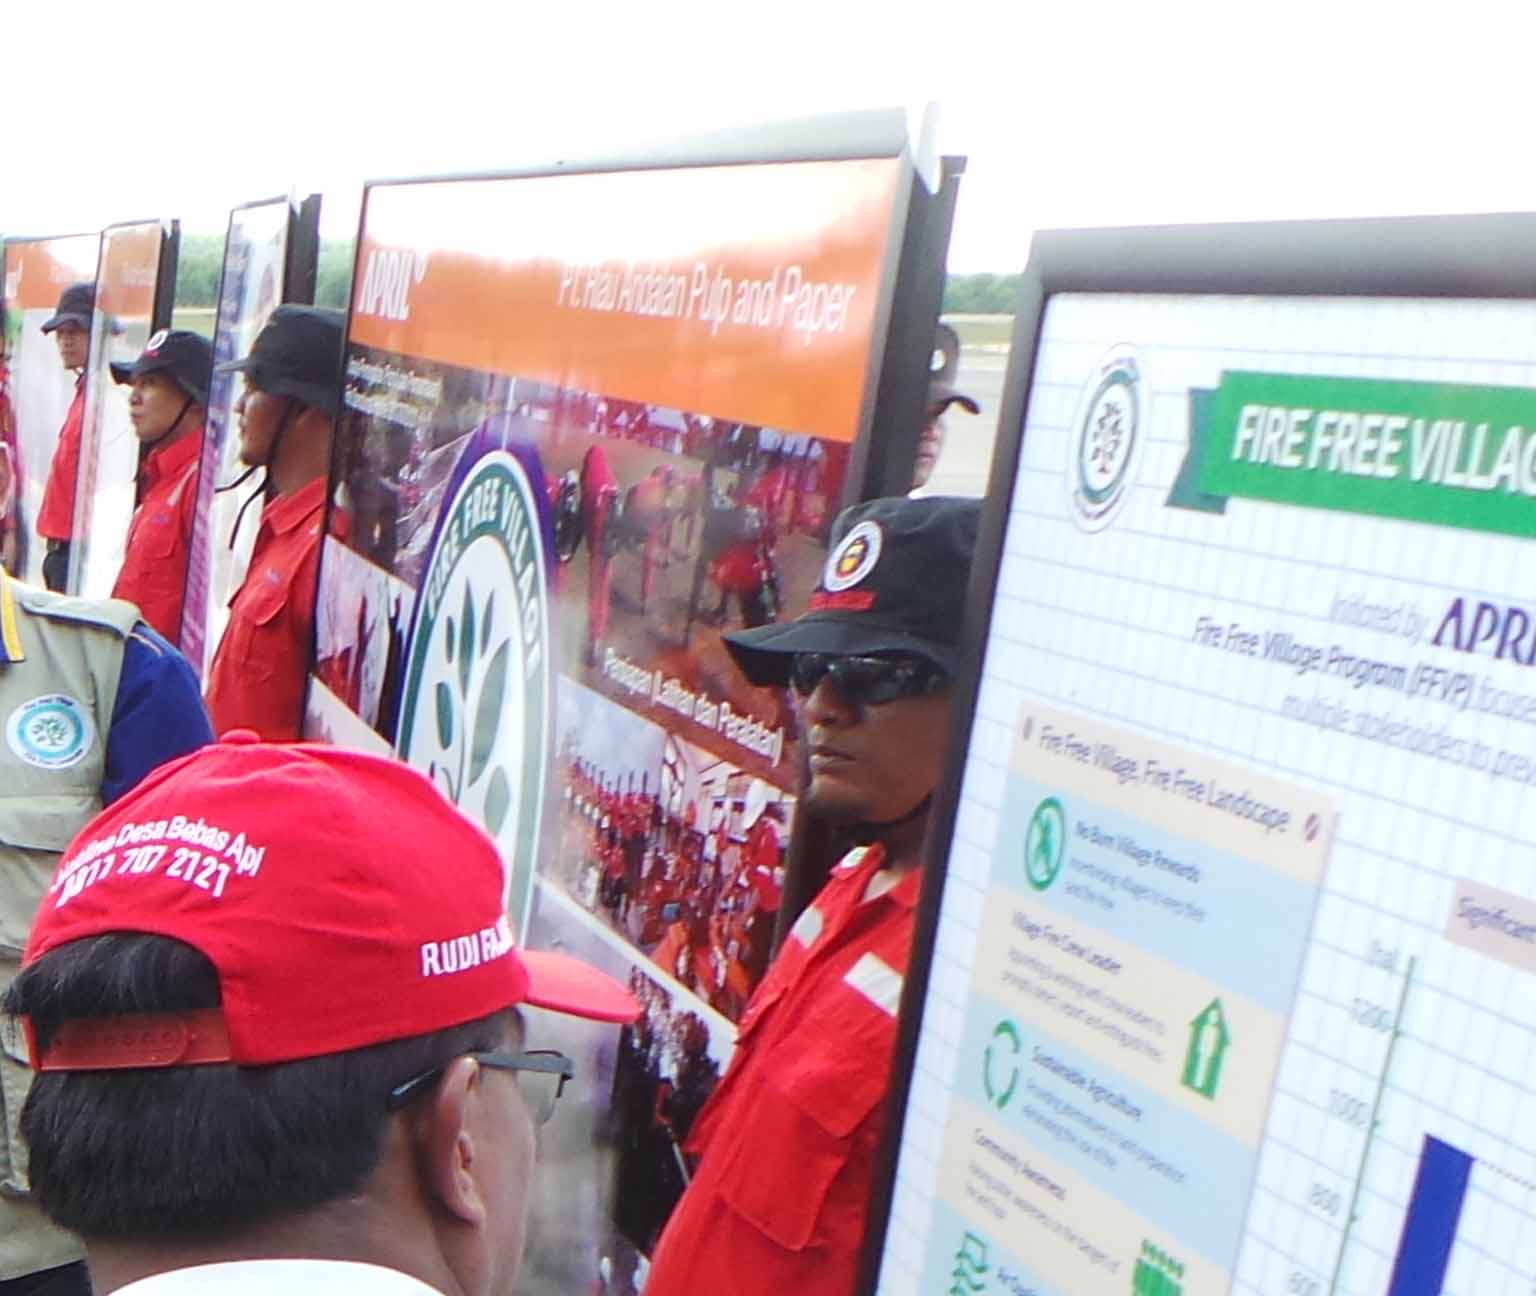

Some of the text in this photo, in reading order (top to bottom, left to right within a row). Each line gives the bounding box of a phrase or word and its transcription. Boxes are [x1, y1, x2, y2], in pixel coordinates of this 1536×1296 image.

[687, 260, 732, 336] Pulp
[733, 264, 780, 327] and
[777, 264, 857, 346] Paper
[1232, 403, 1314, 468] FIRE
[1308, 410, 1409, 479] FREE
[462, 476, 501, 540] FREE
[115, 819, 168, 848] Desa
[166, 815, 231, 851] Bebas
[224, 832, 267, 878] Api
[117, 844, 169, 875] 707
[421, 932, 481, 977] RUDI
